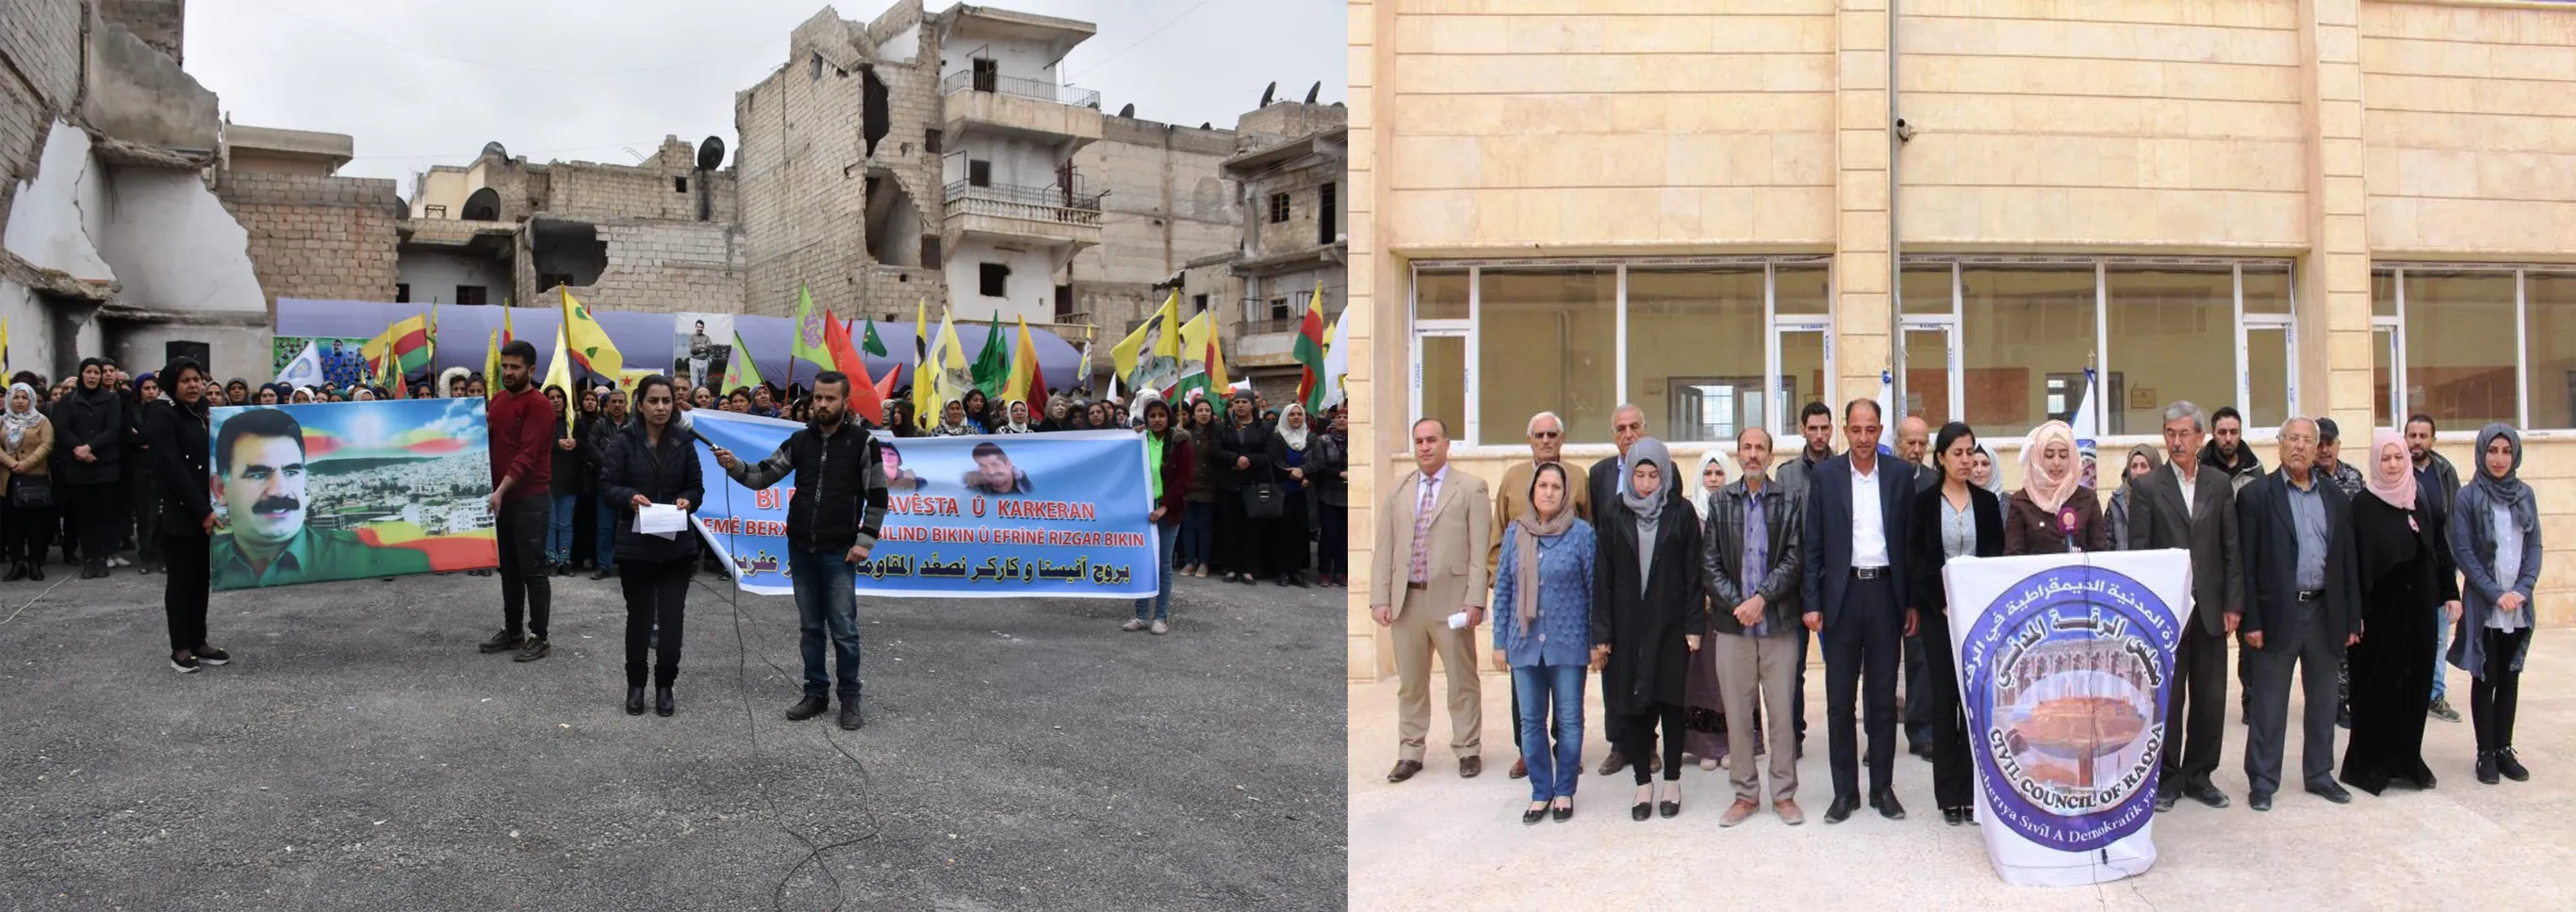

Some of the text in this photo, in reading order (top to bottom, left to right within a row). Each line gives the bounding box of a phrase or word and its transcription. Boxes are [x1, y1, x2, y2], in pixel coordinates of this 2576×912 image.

[756, 487, 781, 510] BI
[972, 494, 986, 517] Û
[997, 499, 1096, 520] KARKERAN
[931, 527, 975, 544] BIKIN
[978, 526, 989, 544] Û
[993, 527, 1045, 545] EFRÎNÊ
[1048, 530, 1102, 546] RIZGAR
[1104, 532, 1145, 547] BIKIN
[857, 553, 914, 580] المقاوم
[1023, 562, 1034, 582] و
[2006, 577, 2105, 615] الديمقراطية
[2108, 583, 2165, 628] المدنية
[1986, 611, 2005, 641] في
[2124, 635, 2163, 688] مجلس
[1990, 723, 2163, 809] CIVIL COUNCIL OF RAQQA
[2053, 829, 2064, 842] A
[2069, 804, 2143, 842] Demokratîk
